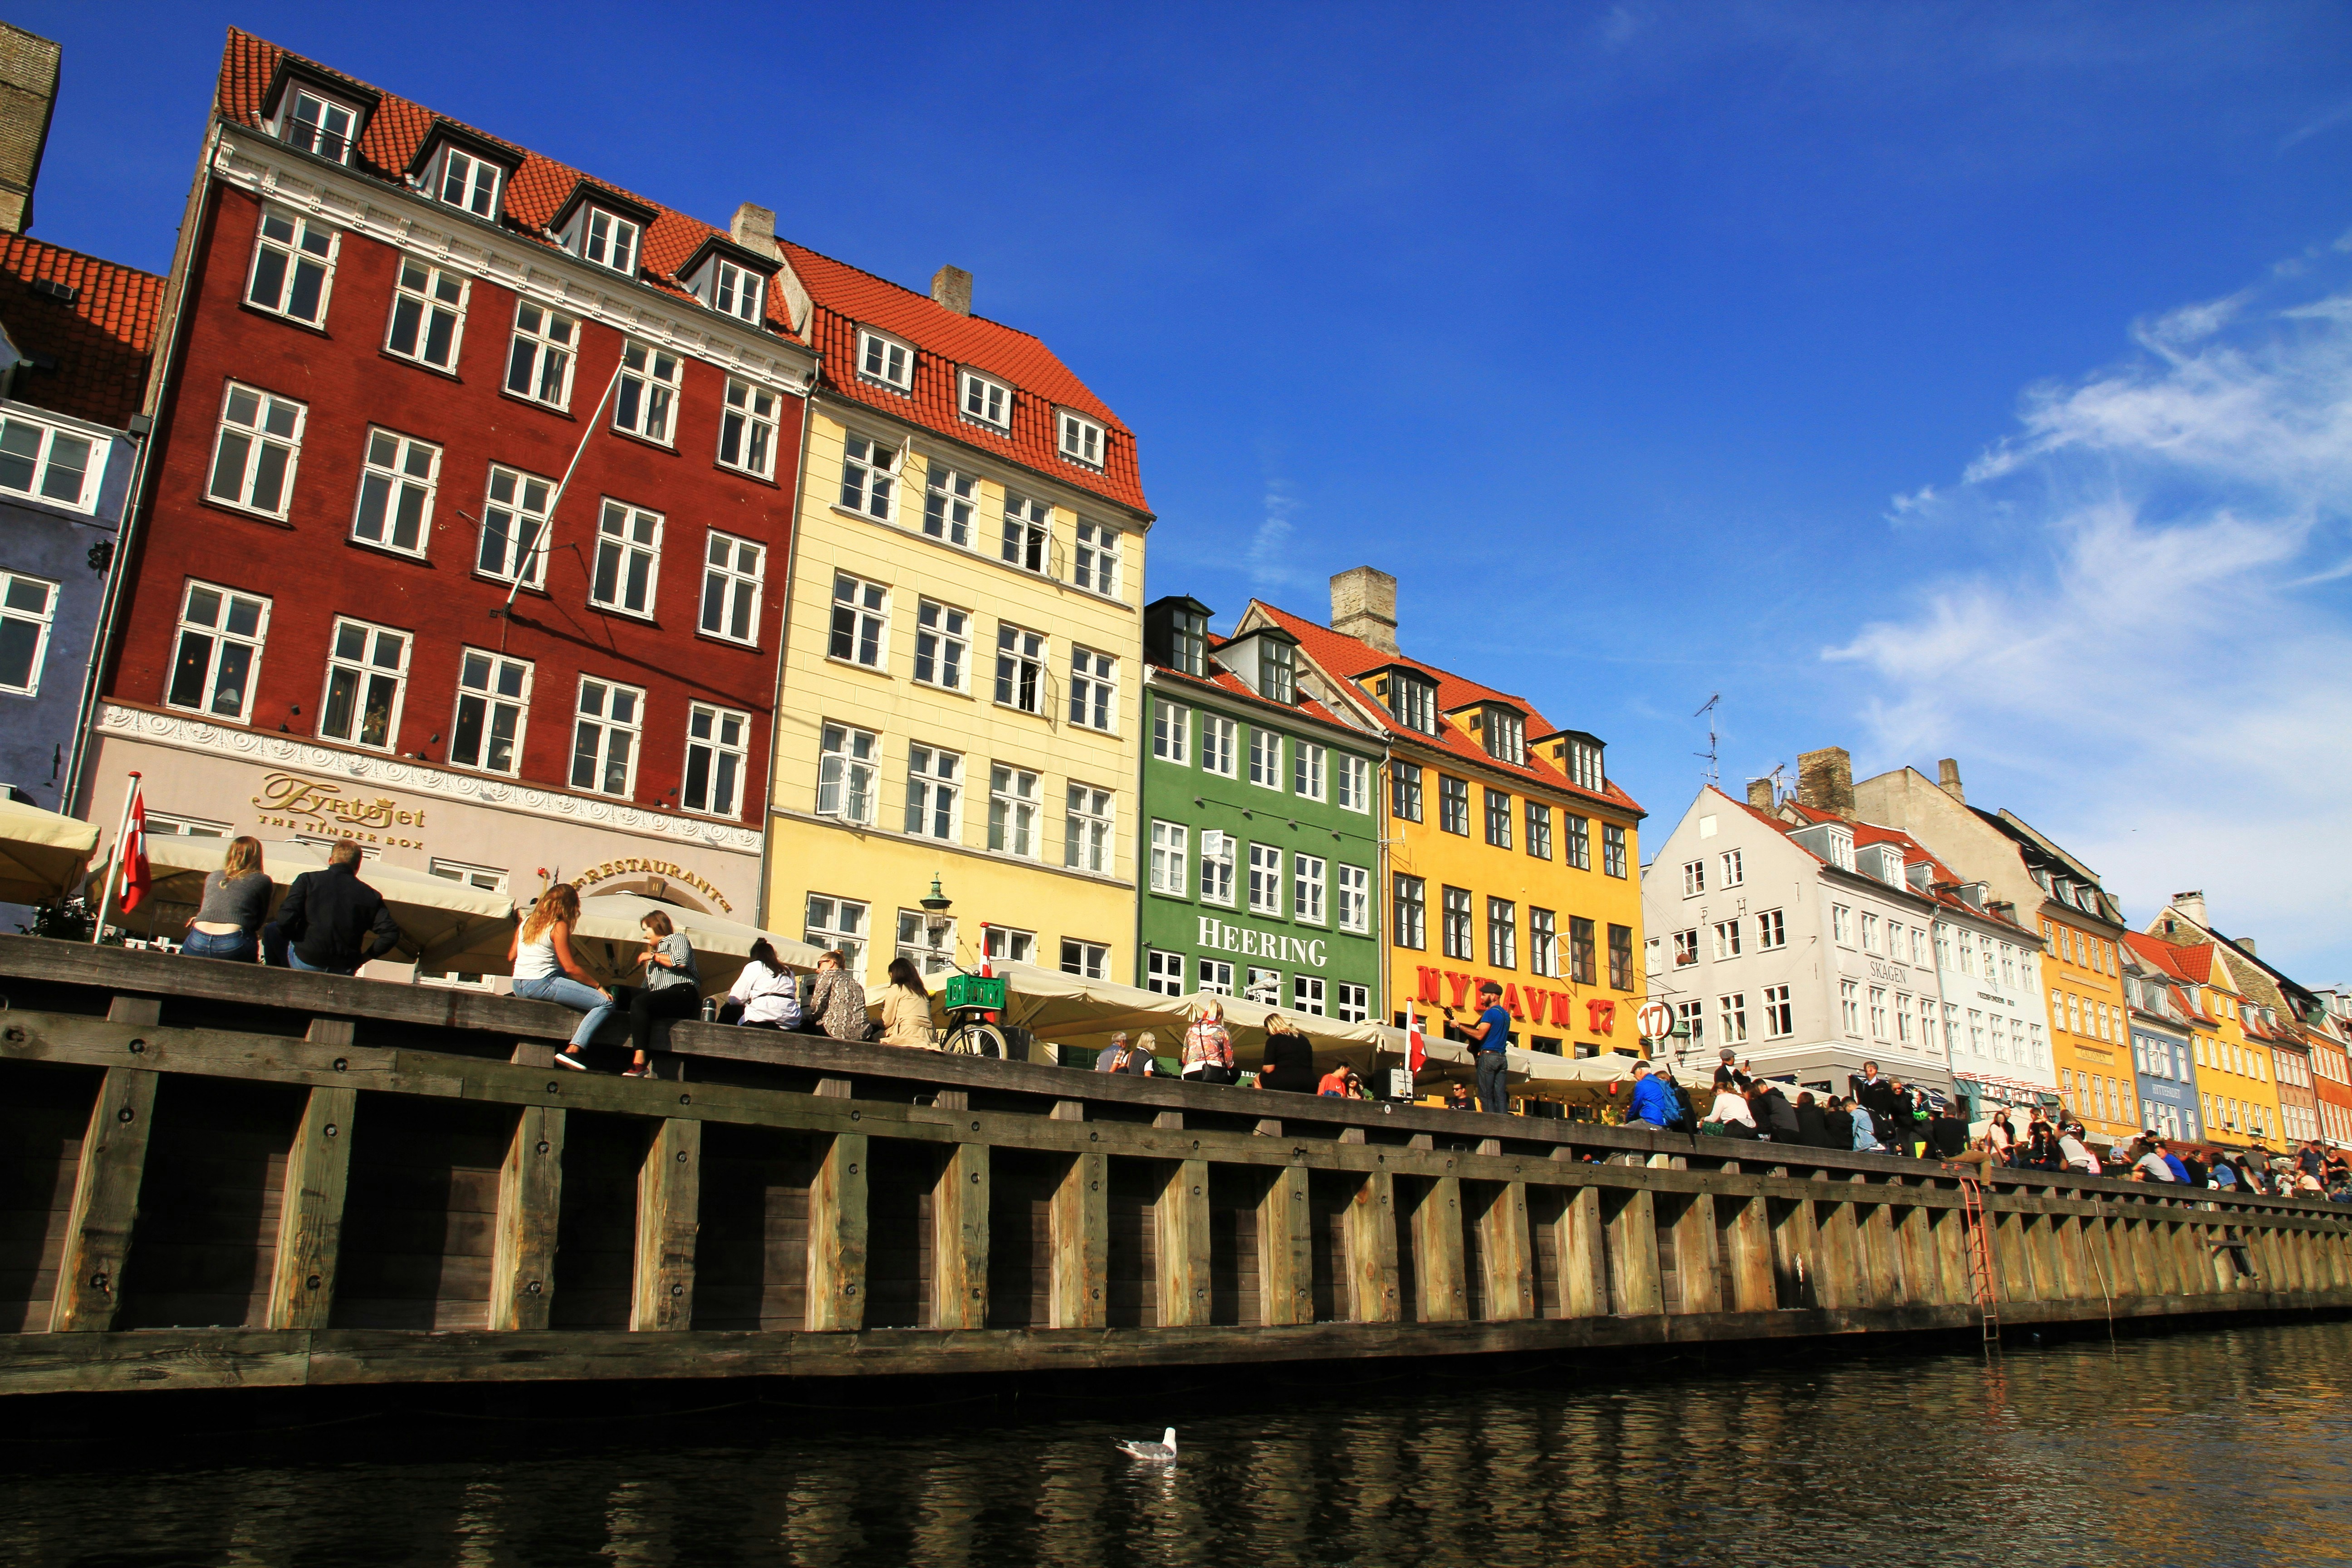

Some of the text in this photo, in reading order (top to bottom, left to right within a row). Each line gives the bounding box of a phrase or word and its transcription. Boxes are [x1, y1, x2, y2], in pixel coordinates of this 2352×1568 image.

[259, 815, 424, 850] THE TINDER BOX
[585, 858, 725, 902] RESTAURANT
[1196, 916, 1328, 967] HEERING
[1870, 960, 1906, 984] SKAGEN
[1253, 993, 1261, 1001] 15
[1586, 999, 1615, 1033] 17
[1639, 1005, 1664, 1037] 17
